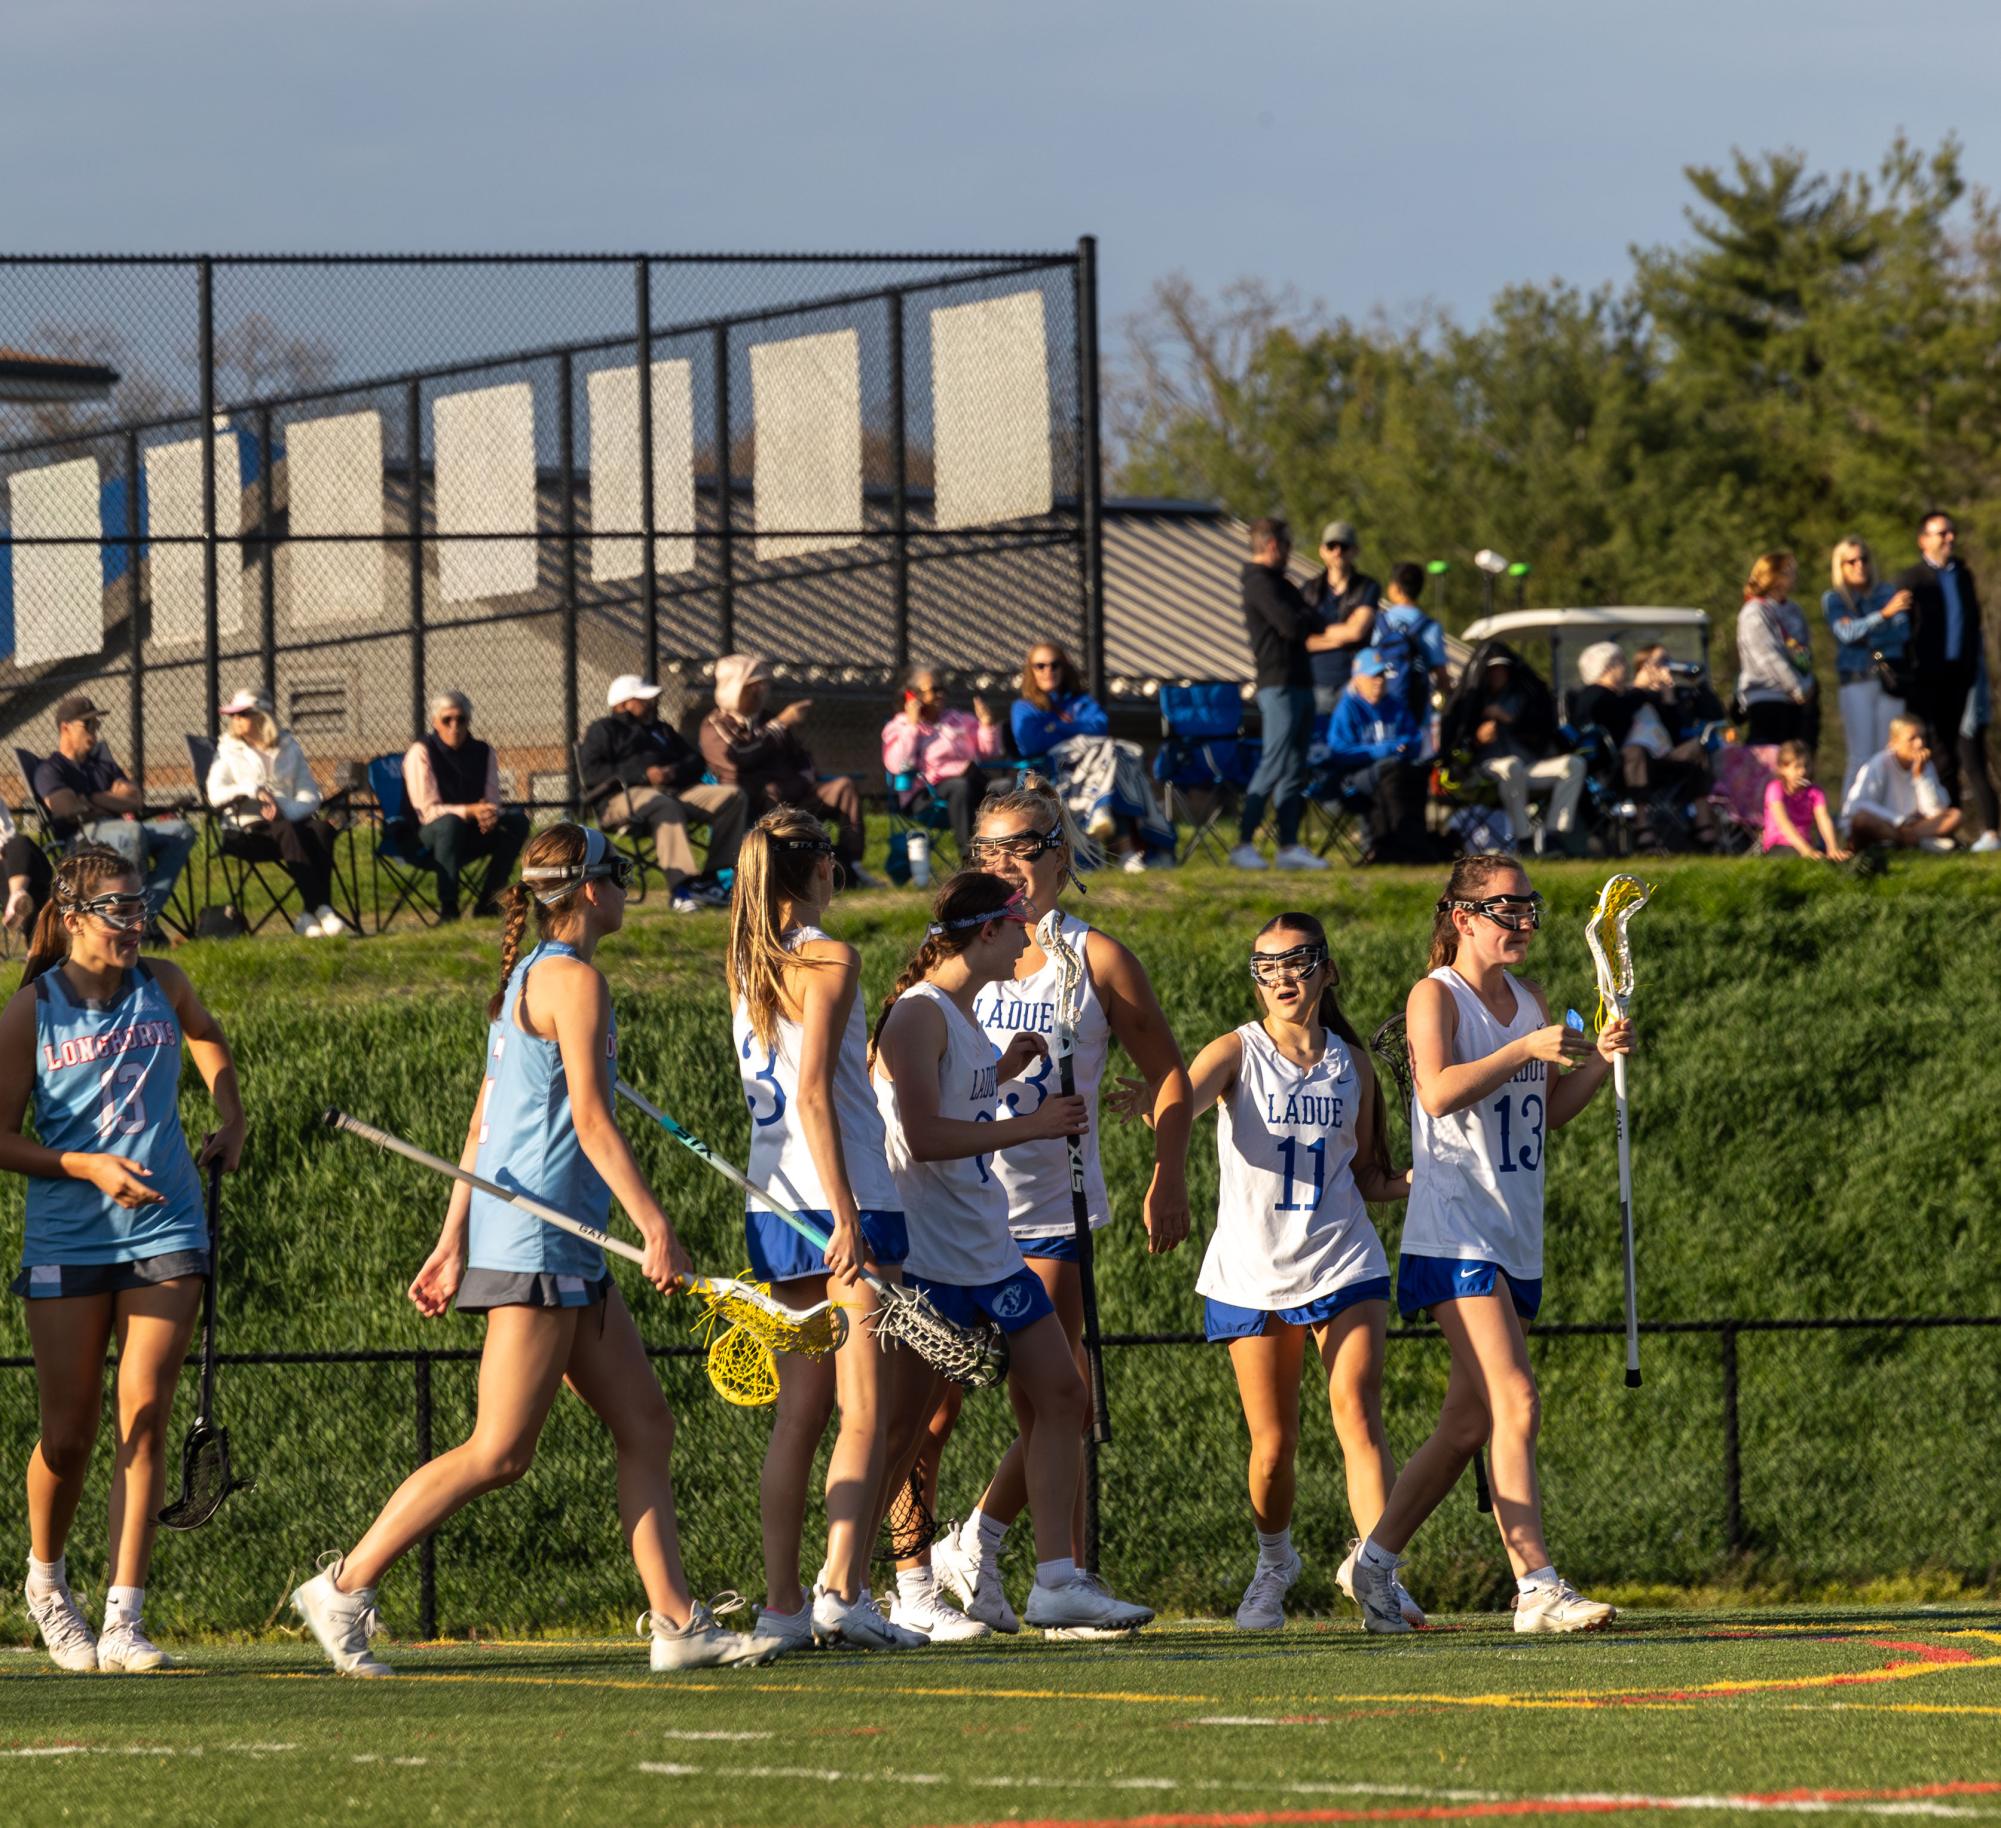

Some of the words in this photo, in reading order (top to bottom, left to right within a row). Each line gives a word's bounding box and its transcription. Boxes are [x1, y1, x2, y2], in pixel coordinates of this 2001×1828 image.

[1454, 900, 1475, 910] STX
[44, 1020, 176, 1072] LONGHORNS
[99, 1062, 146, 1136] 13
[1267, 1093, 1344, 1128] LADUE
[671, 1126, 713, 1161] STX
[1493, 1093, 1544, 1173] 13
[1067, 1143, 1085, 1194] STX
[1274, 1135, 1327, 1212] 11
[579, 1223, 609, 1243] GAIT
